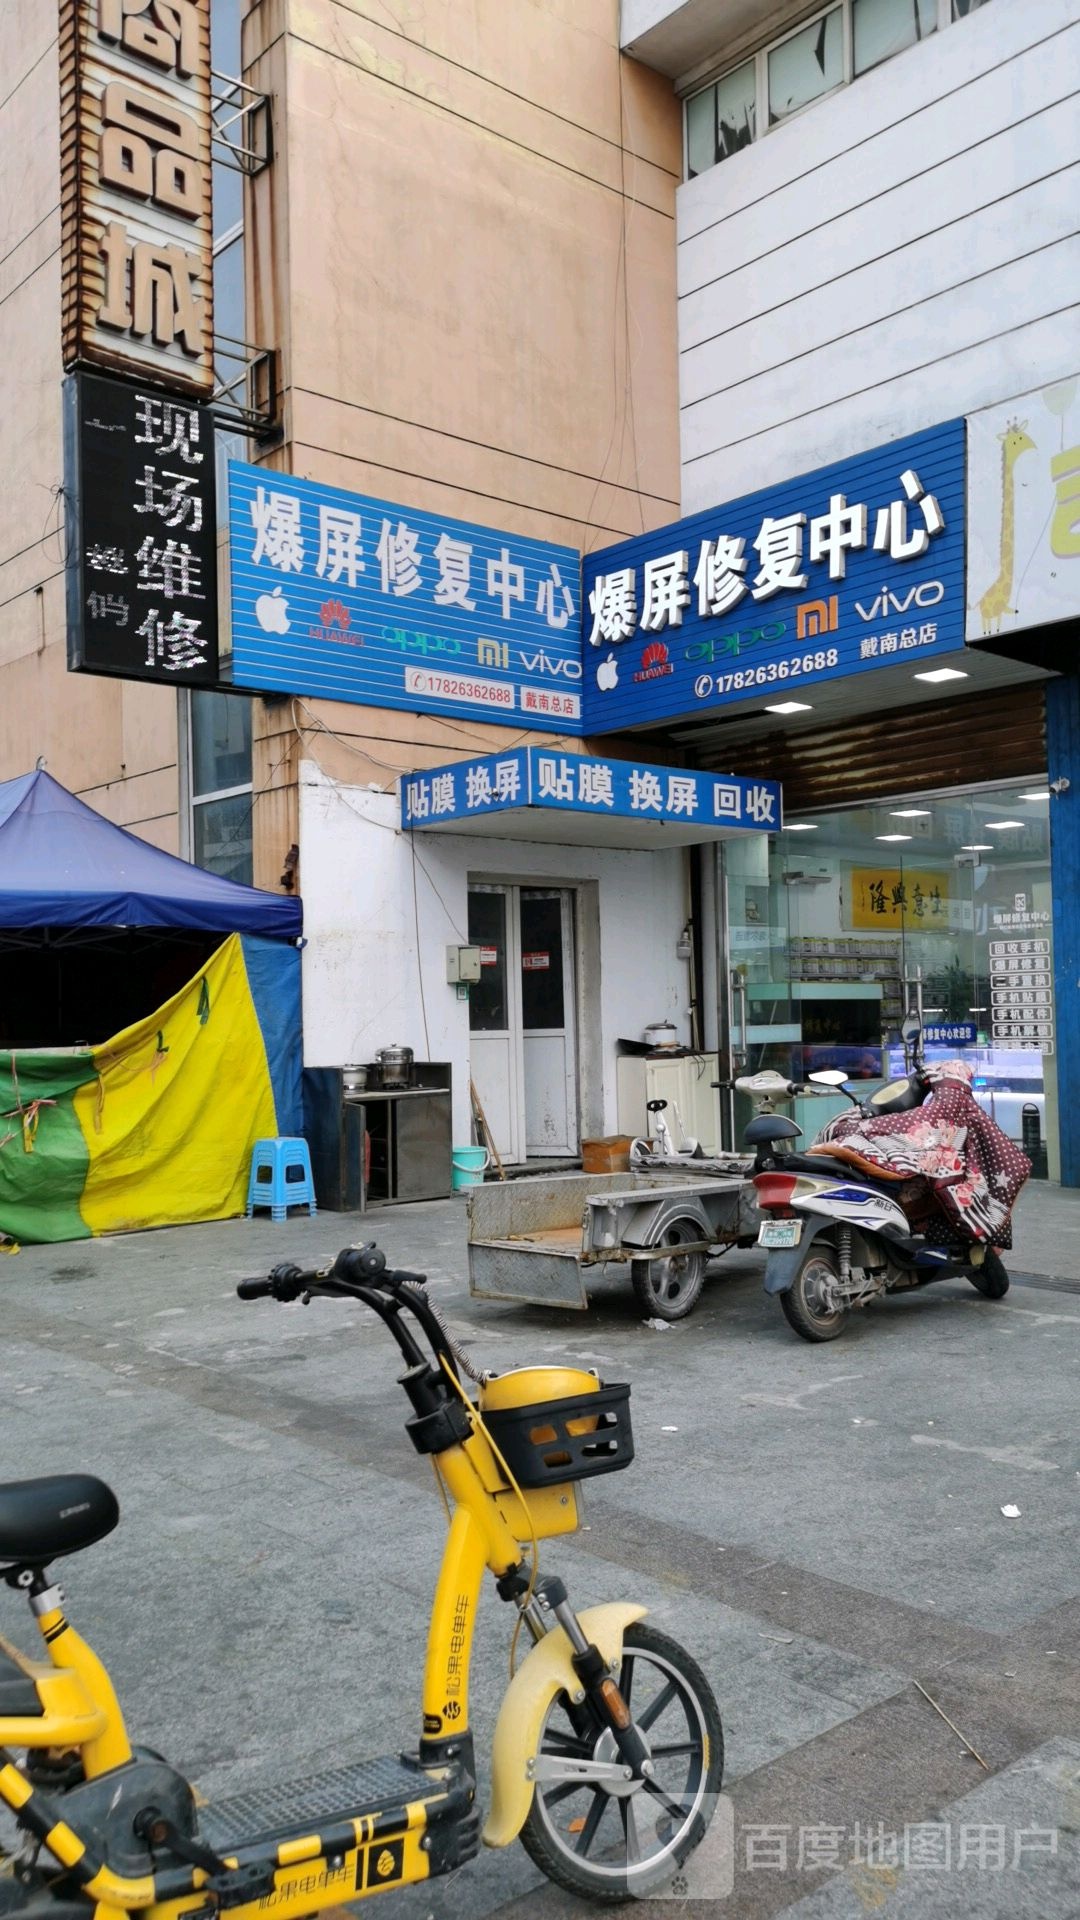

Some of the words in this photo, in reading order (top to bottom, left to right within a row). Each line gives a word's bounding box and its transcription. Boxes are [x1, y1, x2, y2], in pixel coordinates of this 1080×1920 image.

[133, 393, 208, 671] 现场维修
[250, 485, 576, 629] 爆屏修复中心
[588, 469, 946, 647] 爆屏修复中心
[854, 580, 945, 622] vivo
[859, 622, 937, 660] 戴南总店
[519, 649, 583, 679] vivo
[632, 664, 674, 684] HUAWEI
[715, 648, 838, 694] 17826362688
[427, 676, 511, 704] 17826362688
[525, 691, 574, 716] 戴南总店
[406, 772, 456, 821] 贴膜
[466, 758, 521, 809] 换屏
[538, 757, 614, 806] 贴膜
[629, 770, 699, 817] 换屏
[713, 782, 775, 824] 回收
[994, 941, 1045, 954] 回收手机
[996, 991, 1047, 1003] 手机贴膜
[997, 1008, 1048, 1020] 手机配件
